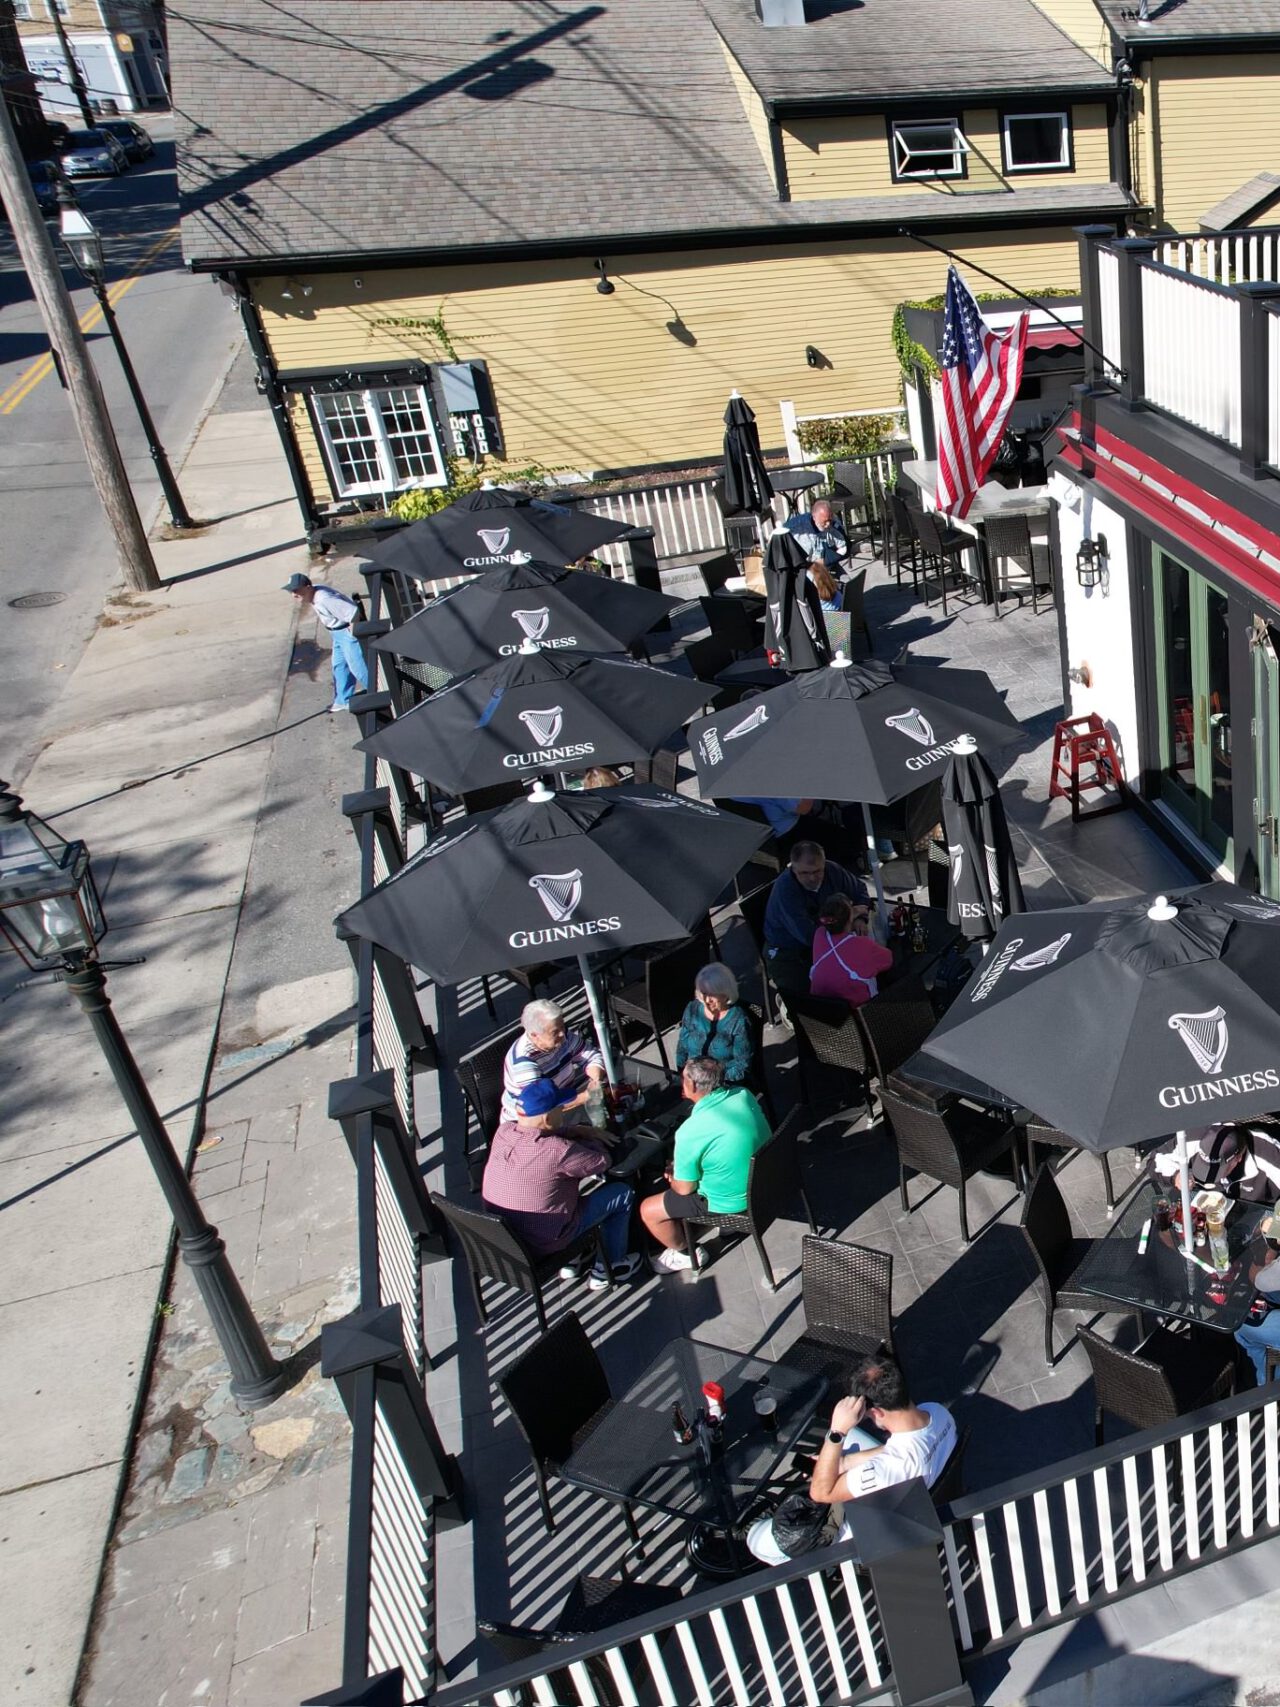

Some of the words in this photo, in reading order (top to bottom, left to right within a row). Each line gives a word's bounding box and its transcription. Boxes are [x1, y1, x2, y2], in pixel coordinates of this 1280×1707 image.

[502, 742, 595, 768] GUINNESS
[702, 727, 724, 766] GUINNESS
[508, 916, 622, 949] GUINNESS
[971, 937, 1024, 1003] GUINNESS
[1158, 1069, 1280, 1108] GUINNESS
